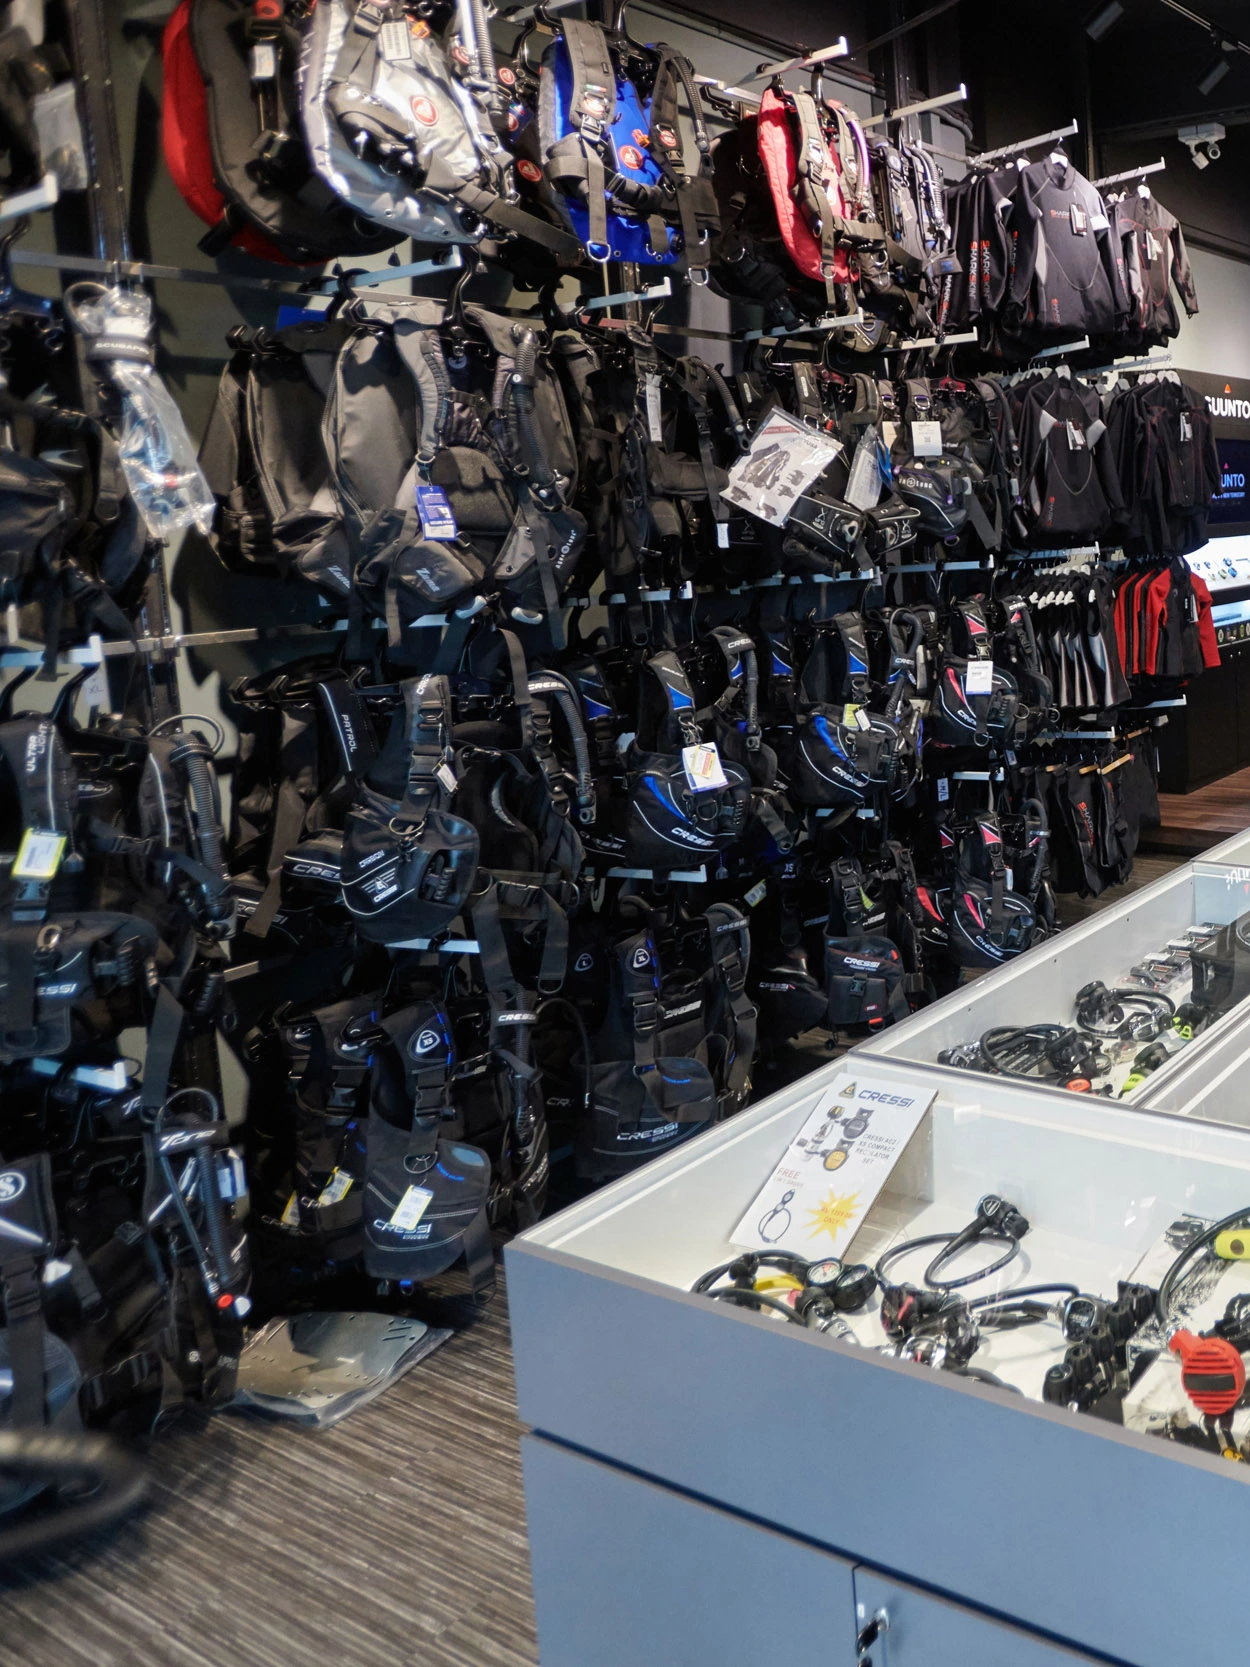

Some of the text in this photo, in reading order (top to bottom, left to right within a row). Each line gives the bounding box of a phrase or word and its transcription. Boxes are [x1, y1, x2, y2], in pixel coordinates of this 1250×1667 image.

[969, 240, 980, 300] SHARKSKIN
[982, 239, 992, 299] SHARKSKIN
[1205, 395, 1250, 419] SUUNTO
[415, 567, 440, 593] Zuma
[341, 714, 356, 753] PATROL
[25, 733, 39, 773] ULTRA
[292, 863, 341, 881] CRES
[843, 955, 881, 969] CRESSI
[37, 983, 78, 996] ESSI
[857, 1089, 916, 1108] CRESSI
[616, 1122, 679, 1141] CRESSI
[867, 1142, 895, 1152] COMPACT
[776, 1167, 801, 1180] FREE
